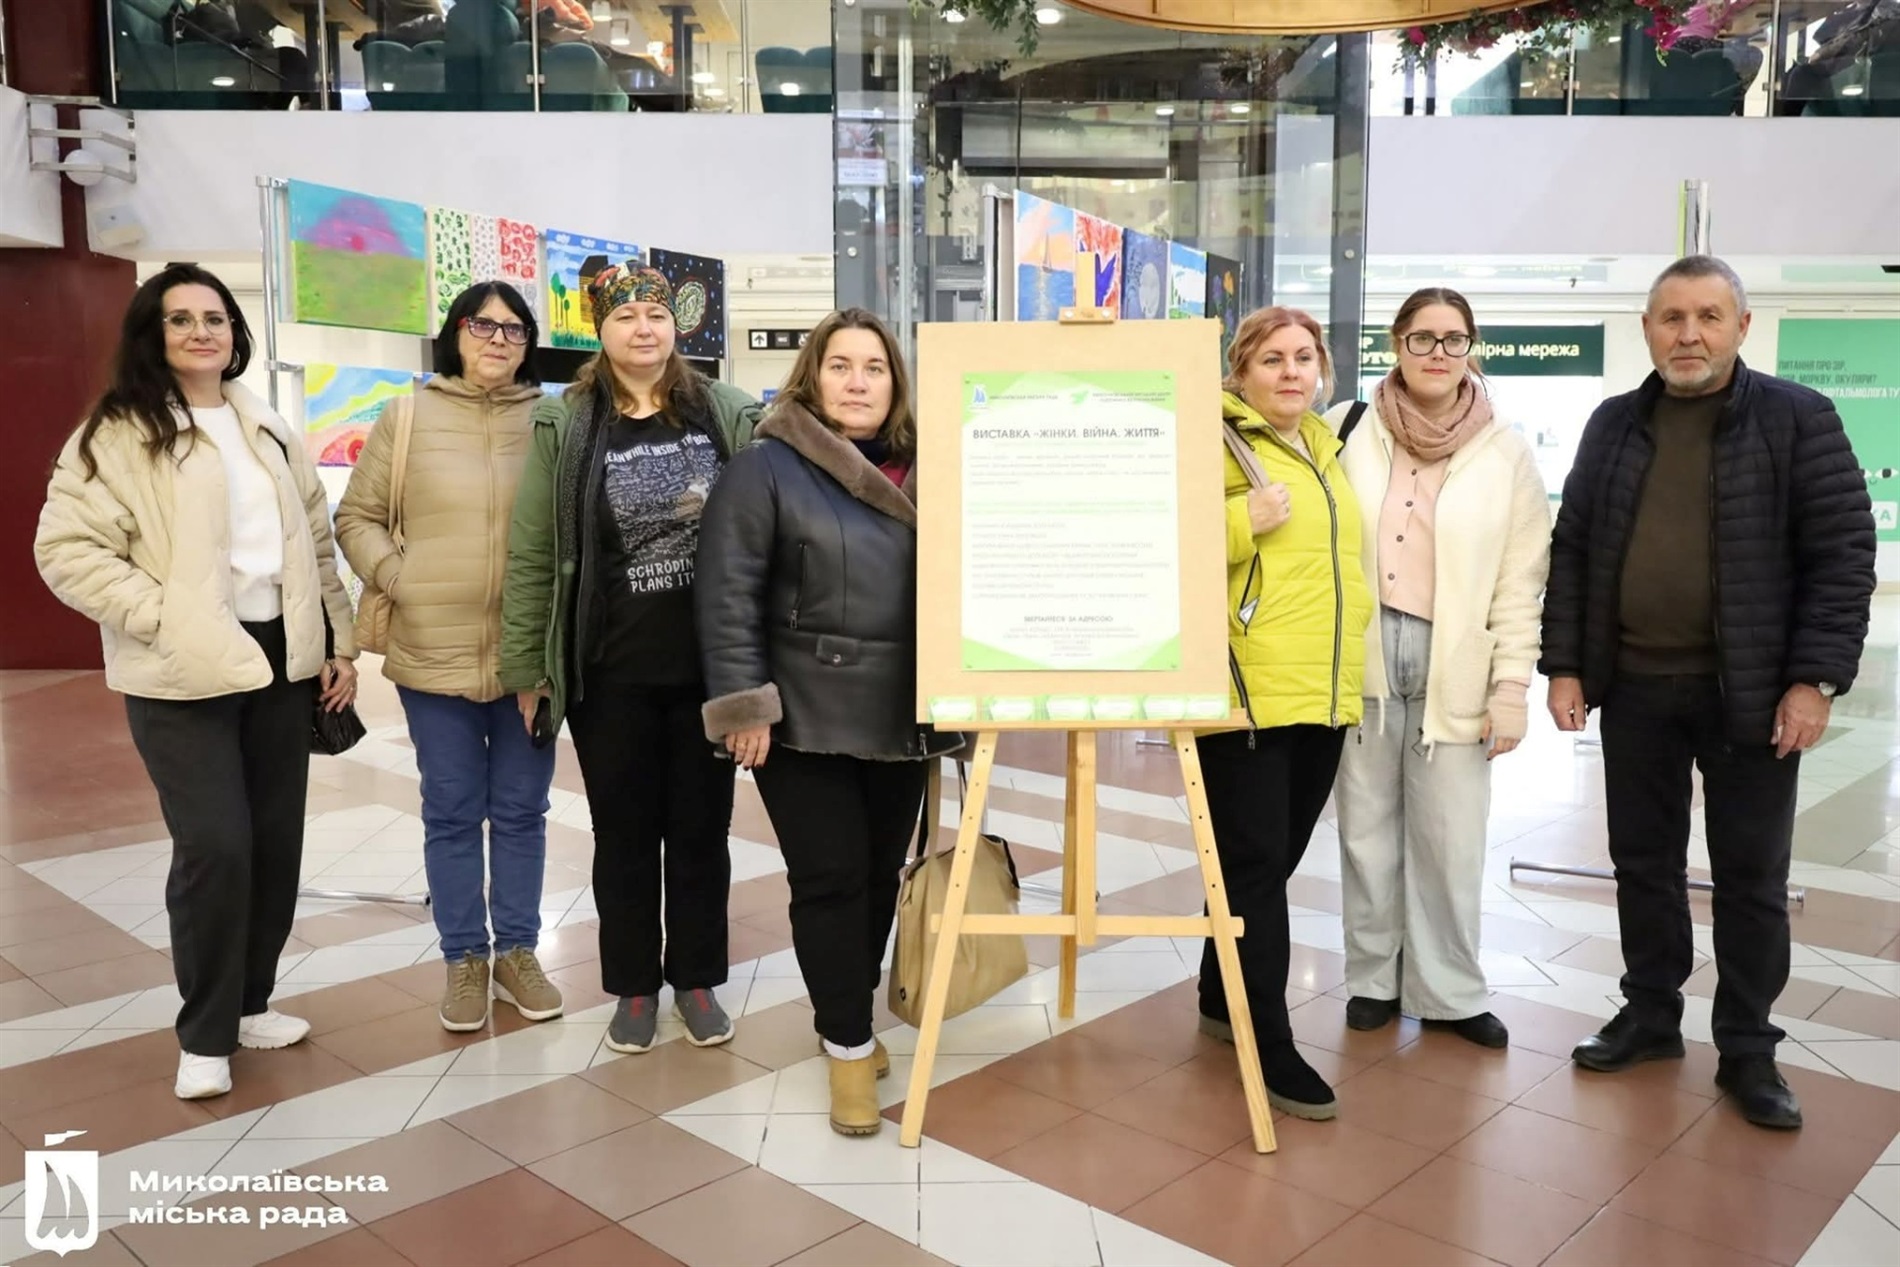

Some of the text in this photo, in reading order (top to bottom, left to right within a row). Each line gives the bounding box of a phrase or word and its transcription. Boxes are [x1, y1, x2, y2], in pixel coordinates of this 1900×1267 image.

[1470, 340, 1580, 360] лірна мережа
[973, 428, 1031, 439] ВИСТАВКА
[1083, 426, 1121, 438] ВІЙНА.
[650, 443, 682, 457] INSIDE
[627, 557, 694, 580] SCHRÖDIN
[630, 575, 673, 594] PLANS
